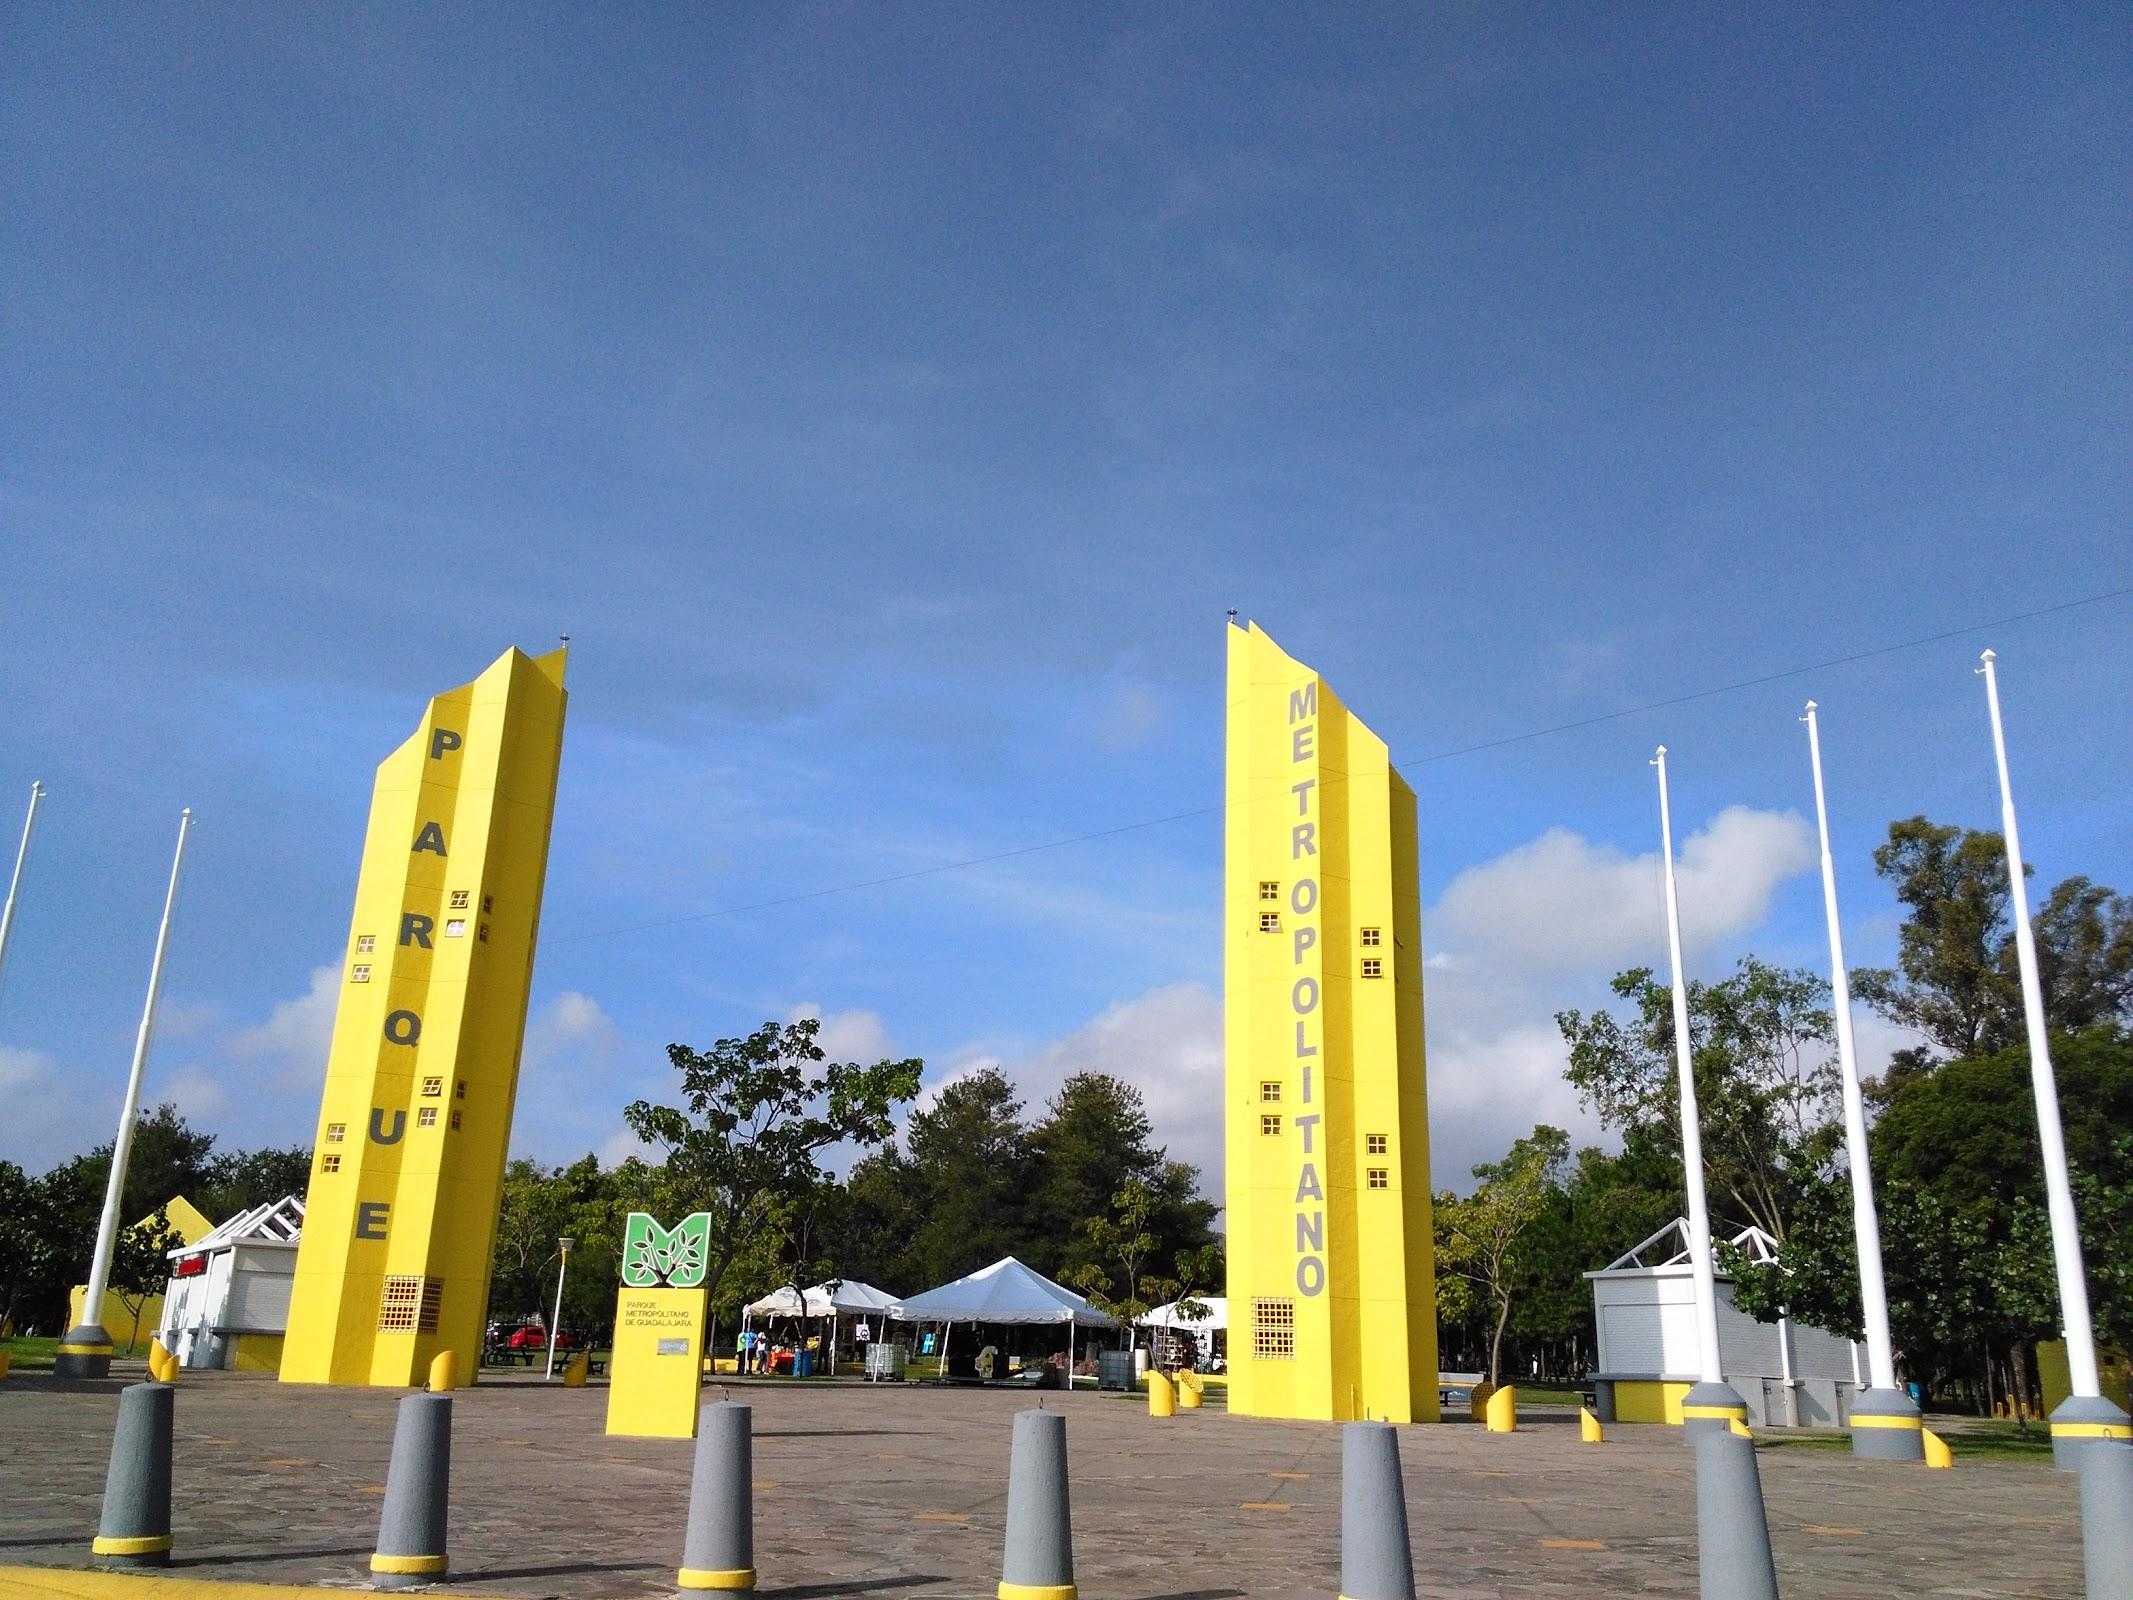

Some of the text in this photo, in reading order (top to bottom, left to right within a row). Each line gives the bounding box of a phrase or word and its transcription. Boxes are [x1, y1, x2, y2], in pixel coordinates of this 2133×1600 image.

[356, 728, 462, 1240] PARQUE
[1289, 682, 1326, 1298] METROPOLITANO
[627, 1301, 657, 1309] PARQUE
[626, 1310, 689, 1318] METROPOLITANO
[637, 1319, 692, 1327] GUADALAJARA
